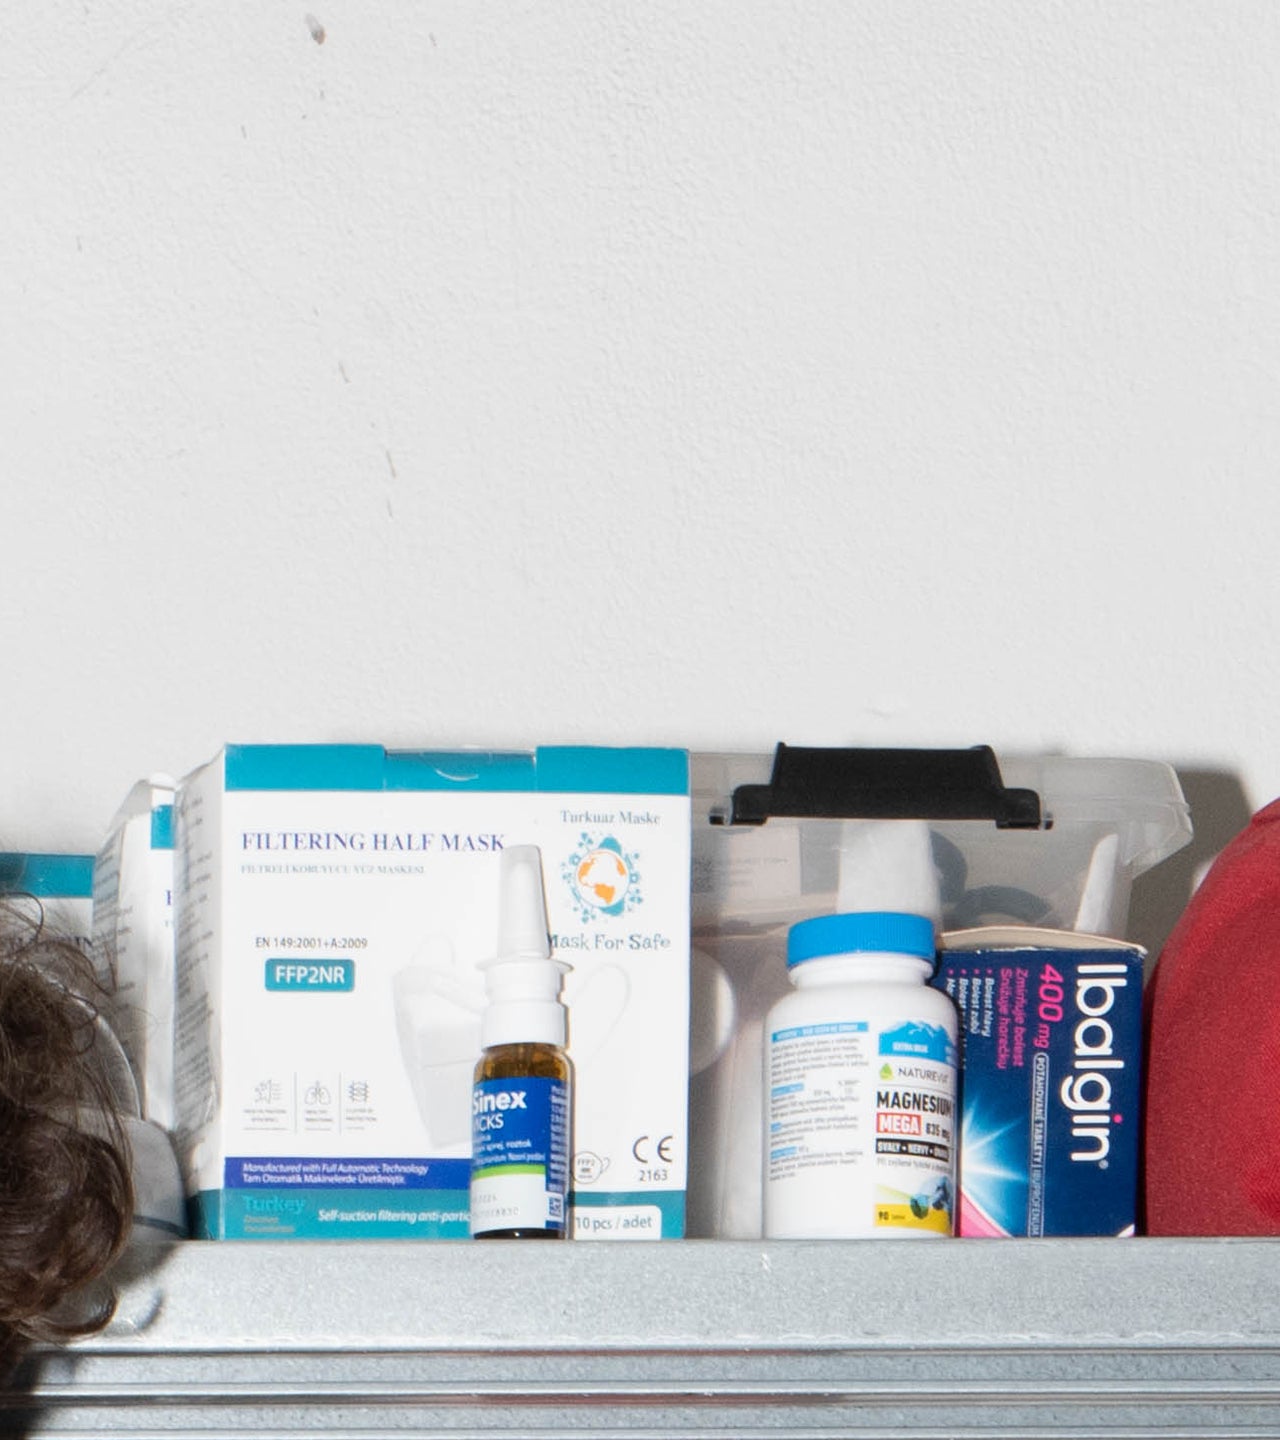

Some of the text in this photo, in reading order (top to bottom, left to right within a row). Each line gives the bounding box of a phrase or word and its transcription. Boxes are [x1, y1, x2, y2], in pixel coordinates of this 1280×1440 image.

[242, 832, 504, 852] FILTERING HALF MASK
[255, 936, 271, 948] EN
[594, 933, 671, 951] For Safe
[275, 965, 345, 984] FFP2NR
[1033, 963, 1064, 1049] 400 mg
[1060, 963, 1128, 1162] Ibalgin
[876, 1089, 954, 1114] MAGNESIUM
[879, 1114, 921, 1135] MEGA
[639, 1168, 668, 1182] 2163
[573, 1214, 591, 1231] 10
[592, 1219, 613, 1233] pcs
[622, 1215, 652, 1229] adet
